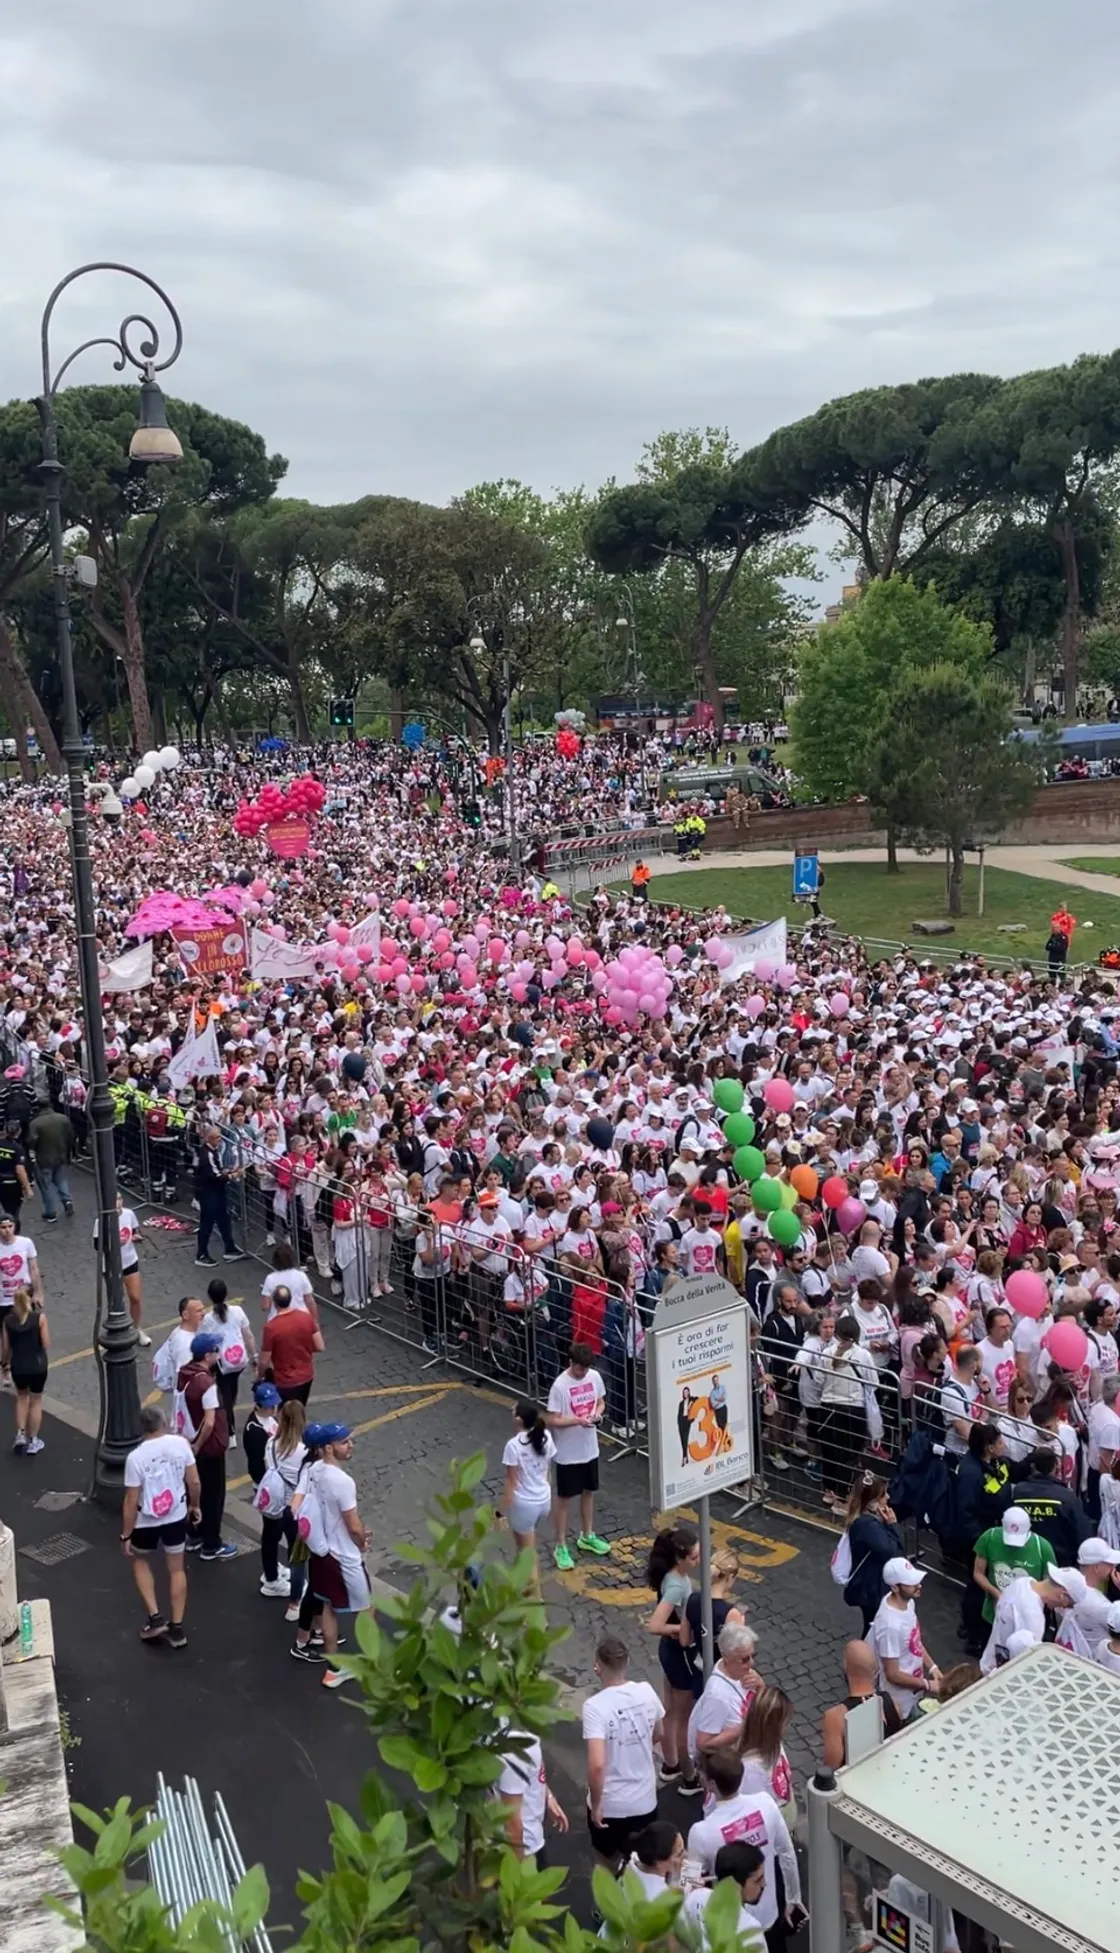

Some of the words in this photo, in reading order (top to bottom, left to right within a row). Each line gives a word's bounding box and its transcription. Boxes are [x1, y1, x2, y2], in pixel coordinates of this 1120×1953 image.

[800, 858, 812, 878] P
[193, 929, 225, 943] DONNE
[664, 1294, 685, 1307] Bocca
[686, 1288, 704, 1300] della
[678, 1332, 684, 1346] È
[686, 1332, 702, 1342] ora
[705, 1326, 714, 1336] di
[716, 1322, 730, 1333] far
[684, 1336, 723, 1354] crescere
[672, 1360, 675, 1369] i
[678, 1353, 696, 1367] tuoi
[698, 1341, 734, 1360] risparmi
